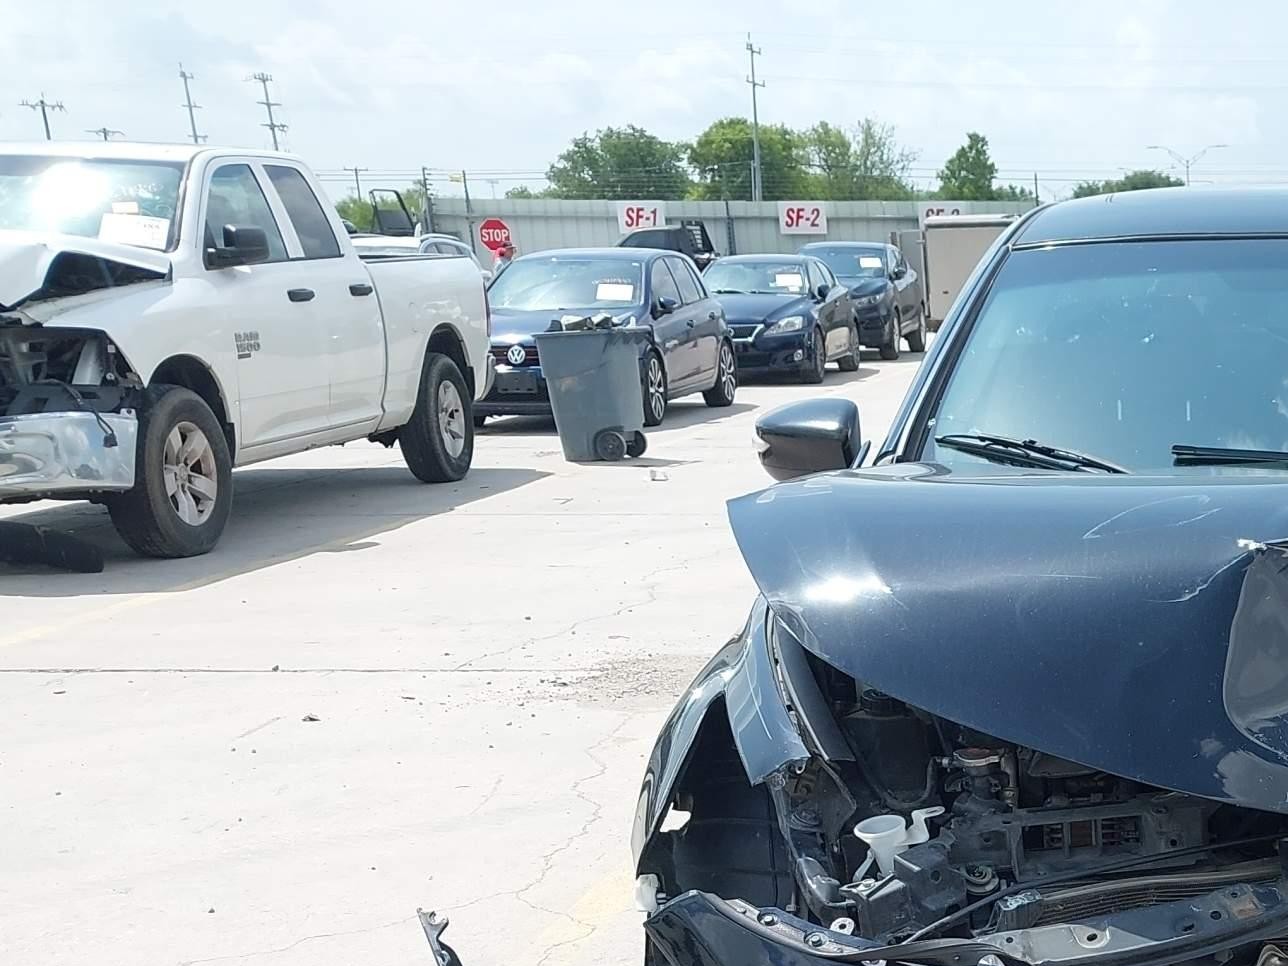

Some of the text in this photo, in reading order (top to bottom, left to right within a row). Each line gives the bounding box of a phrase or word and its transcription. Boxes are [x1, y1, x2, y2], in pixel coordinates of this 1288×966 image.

[625, 207, 658, 228] SF-1
[785, 207, 820, 228] SF-2
[481, 228, 508, 242] STOP
